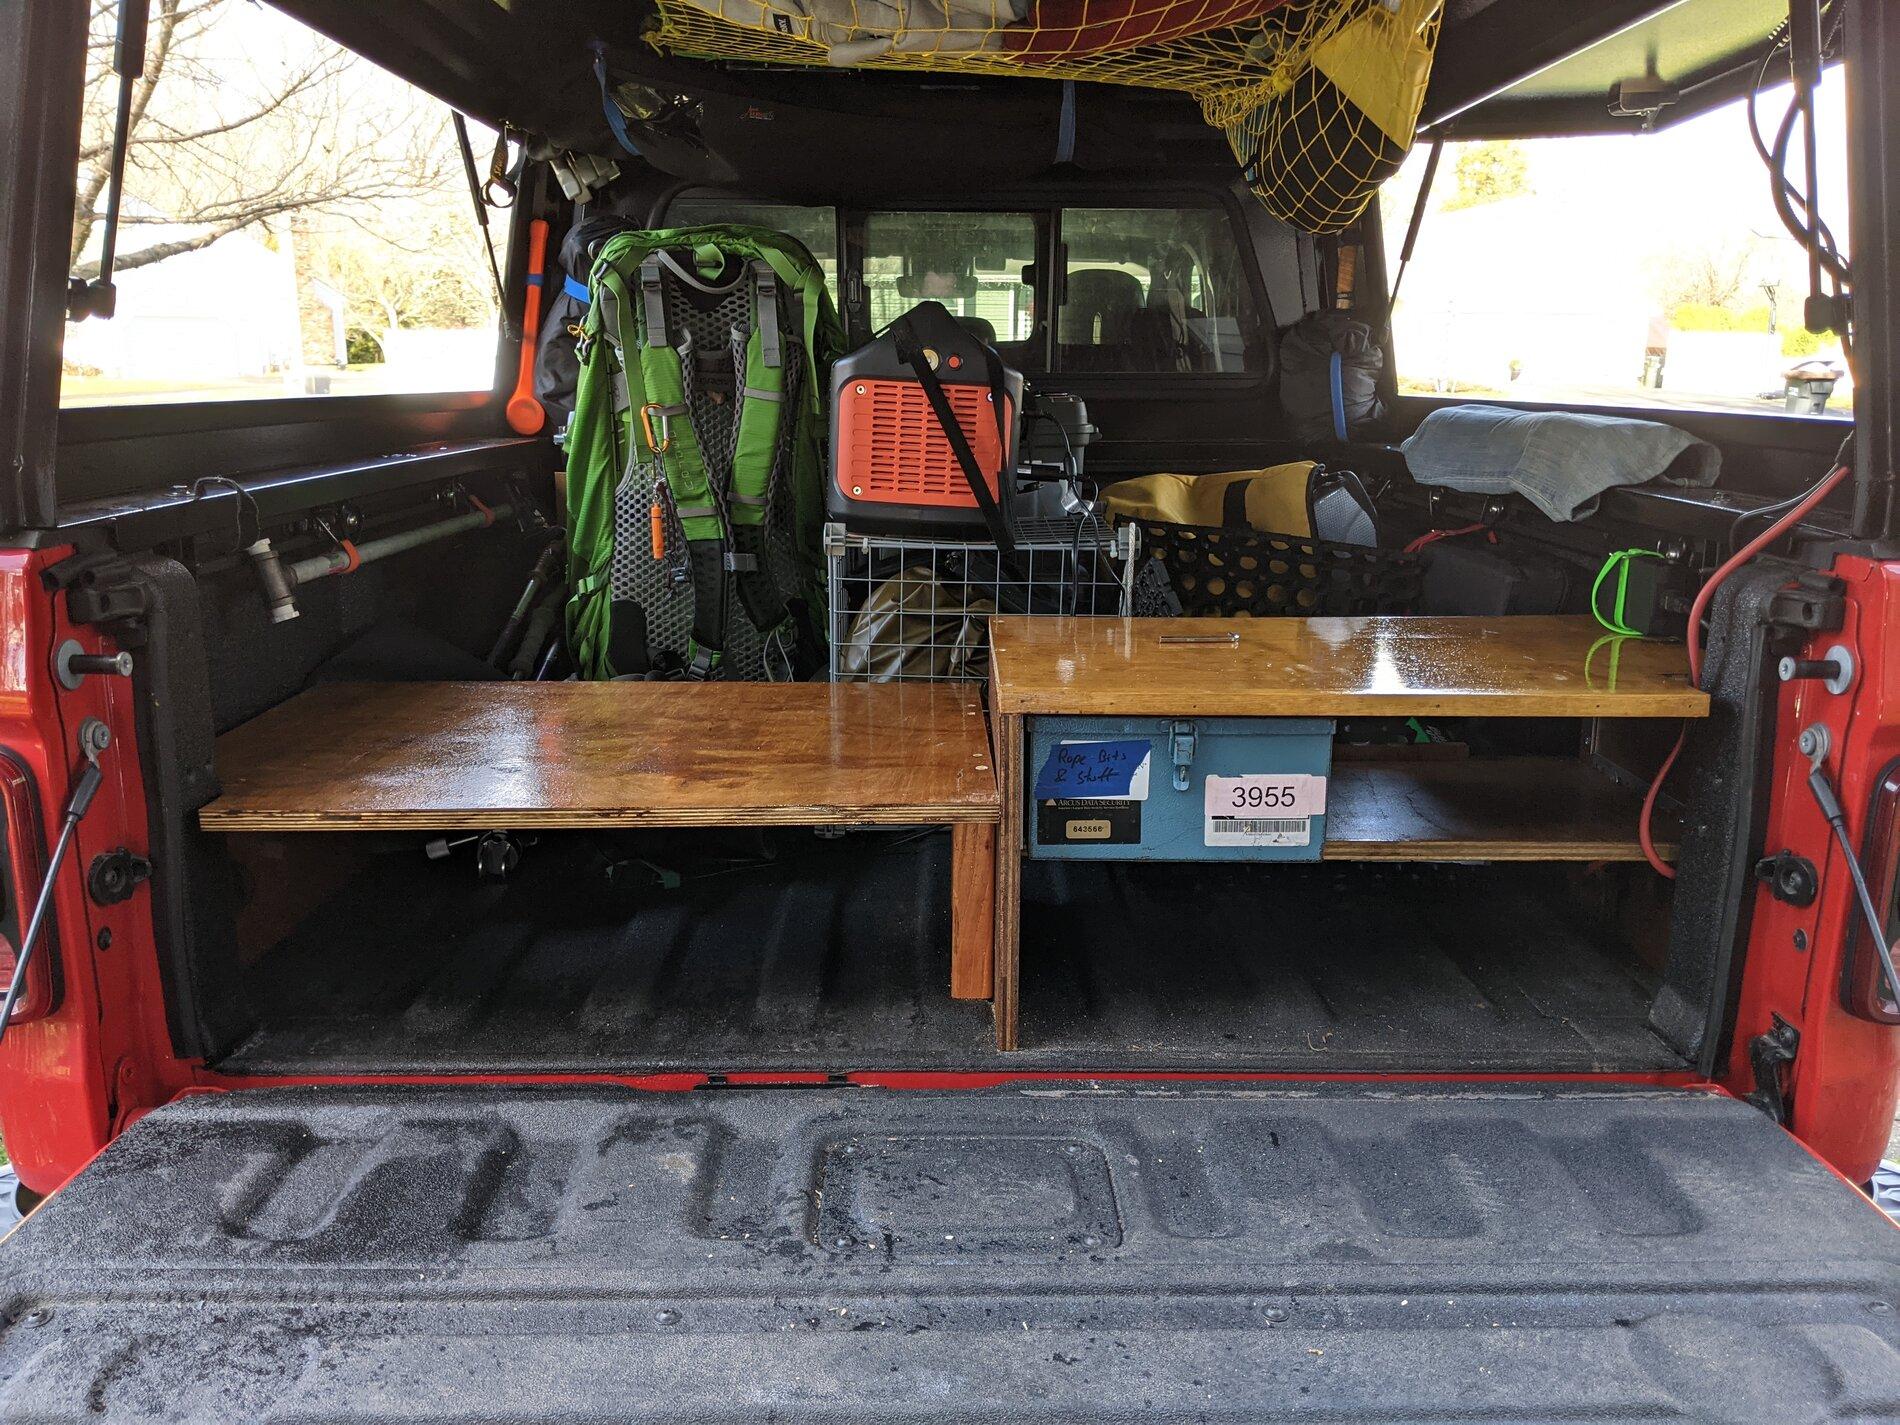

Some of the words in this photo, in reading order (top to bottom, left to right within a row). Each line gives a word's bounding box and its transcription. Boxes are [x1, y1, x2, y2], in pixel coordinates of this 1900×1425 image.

[1059, 748, 1086, 768] Rope
[1098, 749, 1126, 763] Bits
[1231, 786, 1296, 808] 3955
